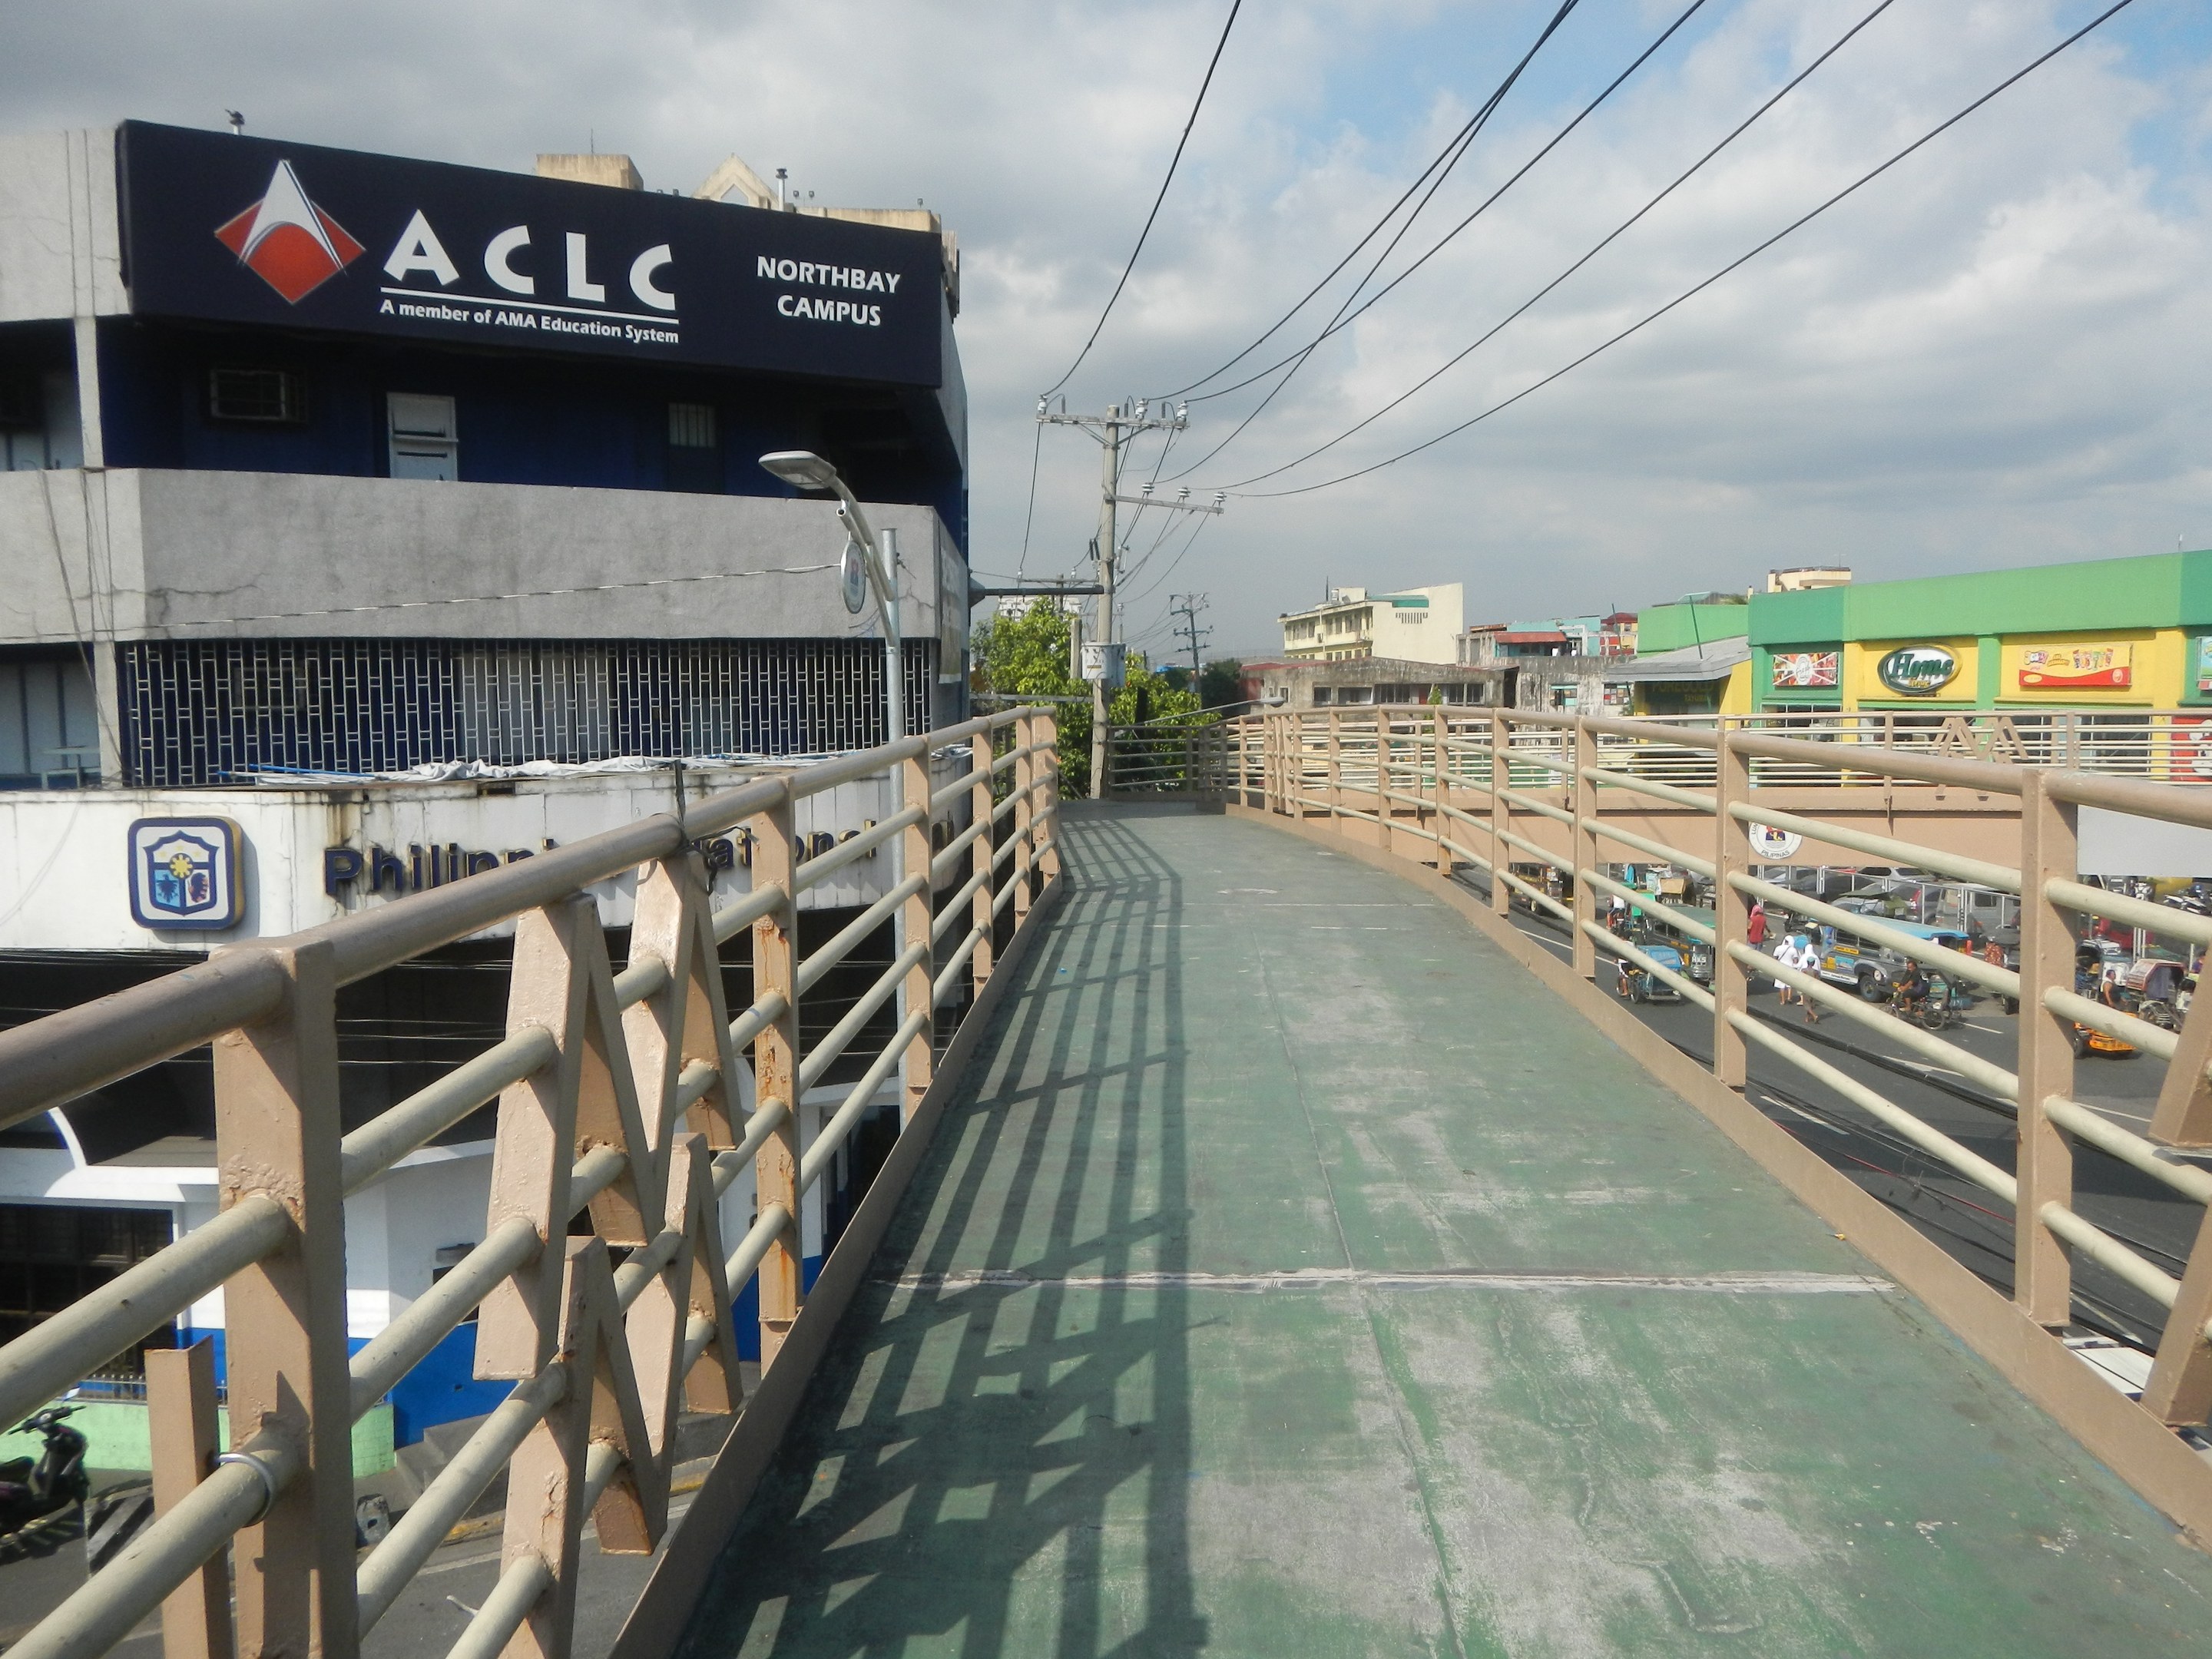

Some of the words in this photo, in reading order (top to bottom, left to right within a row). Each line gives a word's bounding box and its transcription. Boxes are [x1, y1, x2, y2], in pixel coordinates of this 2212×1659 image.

[383, 209, 676, 310] ACLC
[757, 255, 901, 293] NORTHBAY
[380, 299, 395, 314] A
[399, 302, 470, 323] member
[473, 310, 492, 325] of
[494, 311, 537, 329] AMA
[541, 316, 621, 337] Education
[624, 324, 679, 344] System
[777, 294, 881, 326] CAMPUS
[1890, 654, 1955, 677] Home
[1760, 849, 1790, 858] PILIPINAS
